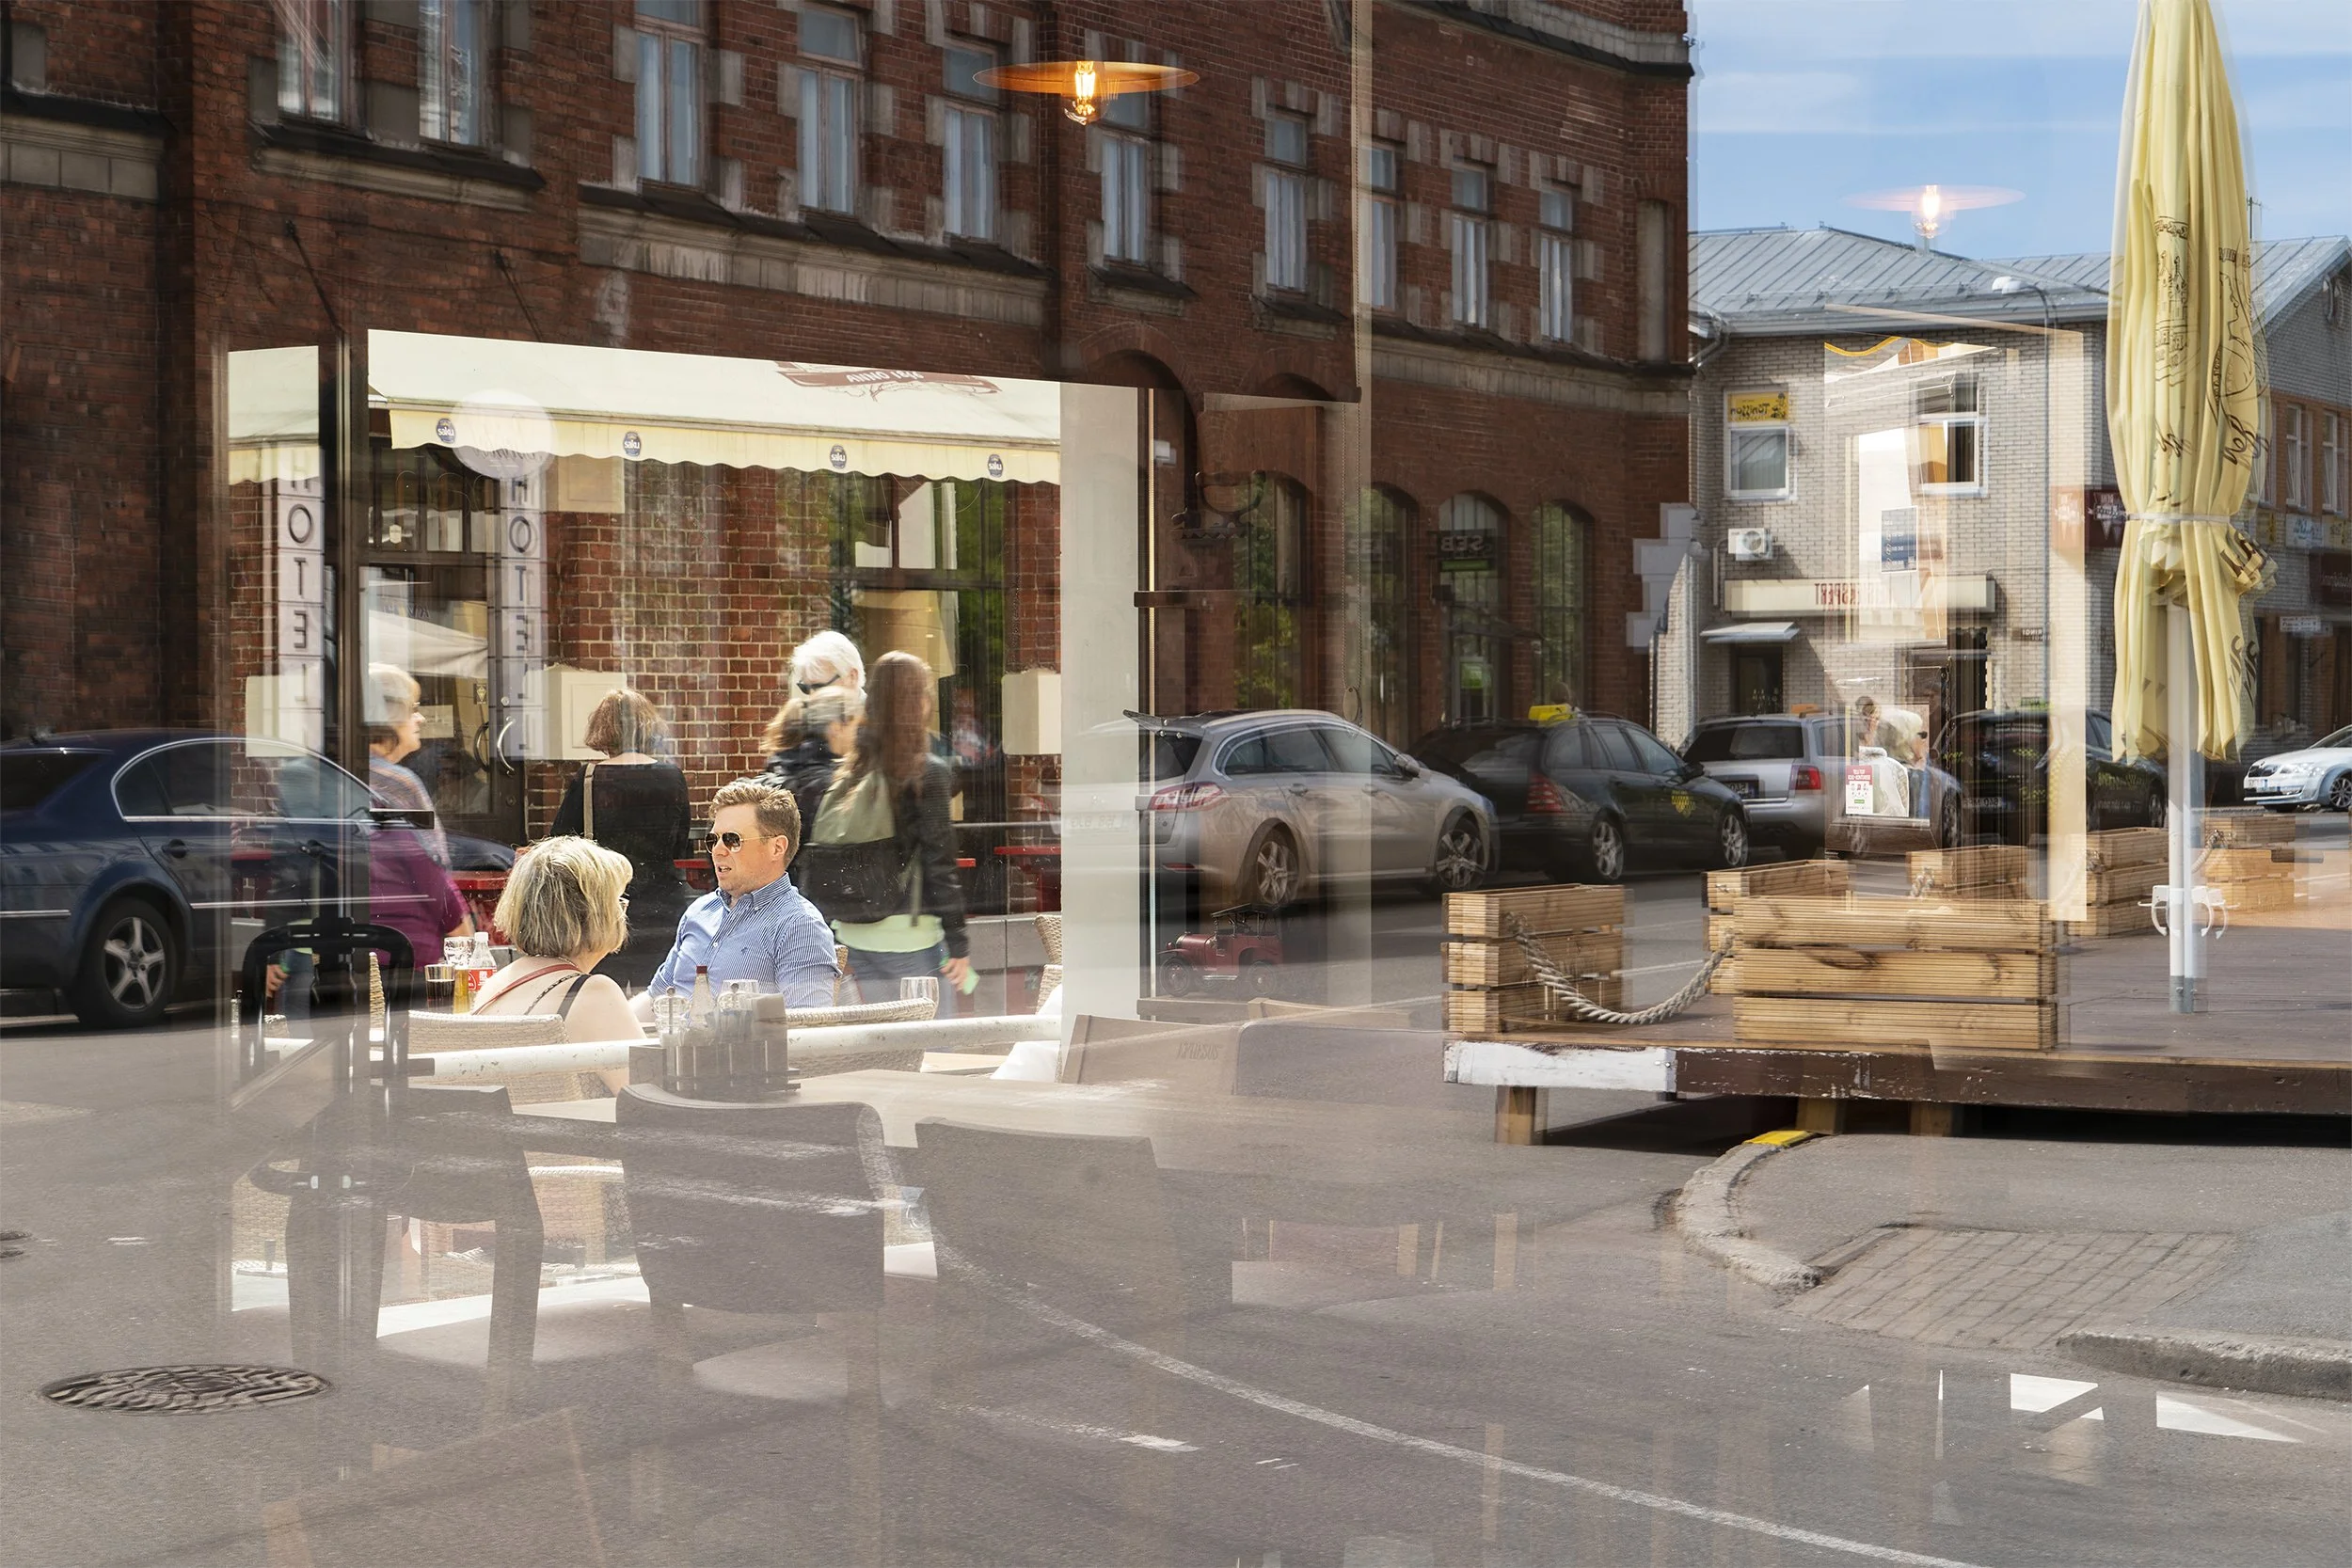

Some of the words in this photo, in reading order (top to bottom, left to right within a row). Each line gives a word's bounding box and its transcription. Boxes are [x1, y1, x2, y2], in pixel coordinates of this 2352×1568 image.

[847, 371, 890, 383] ANNO
[437, 426, 454, 436] saku
[831, 451, 846, 462] saku
